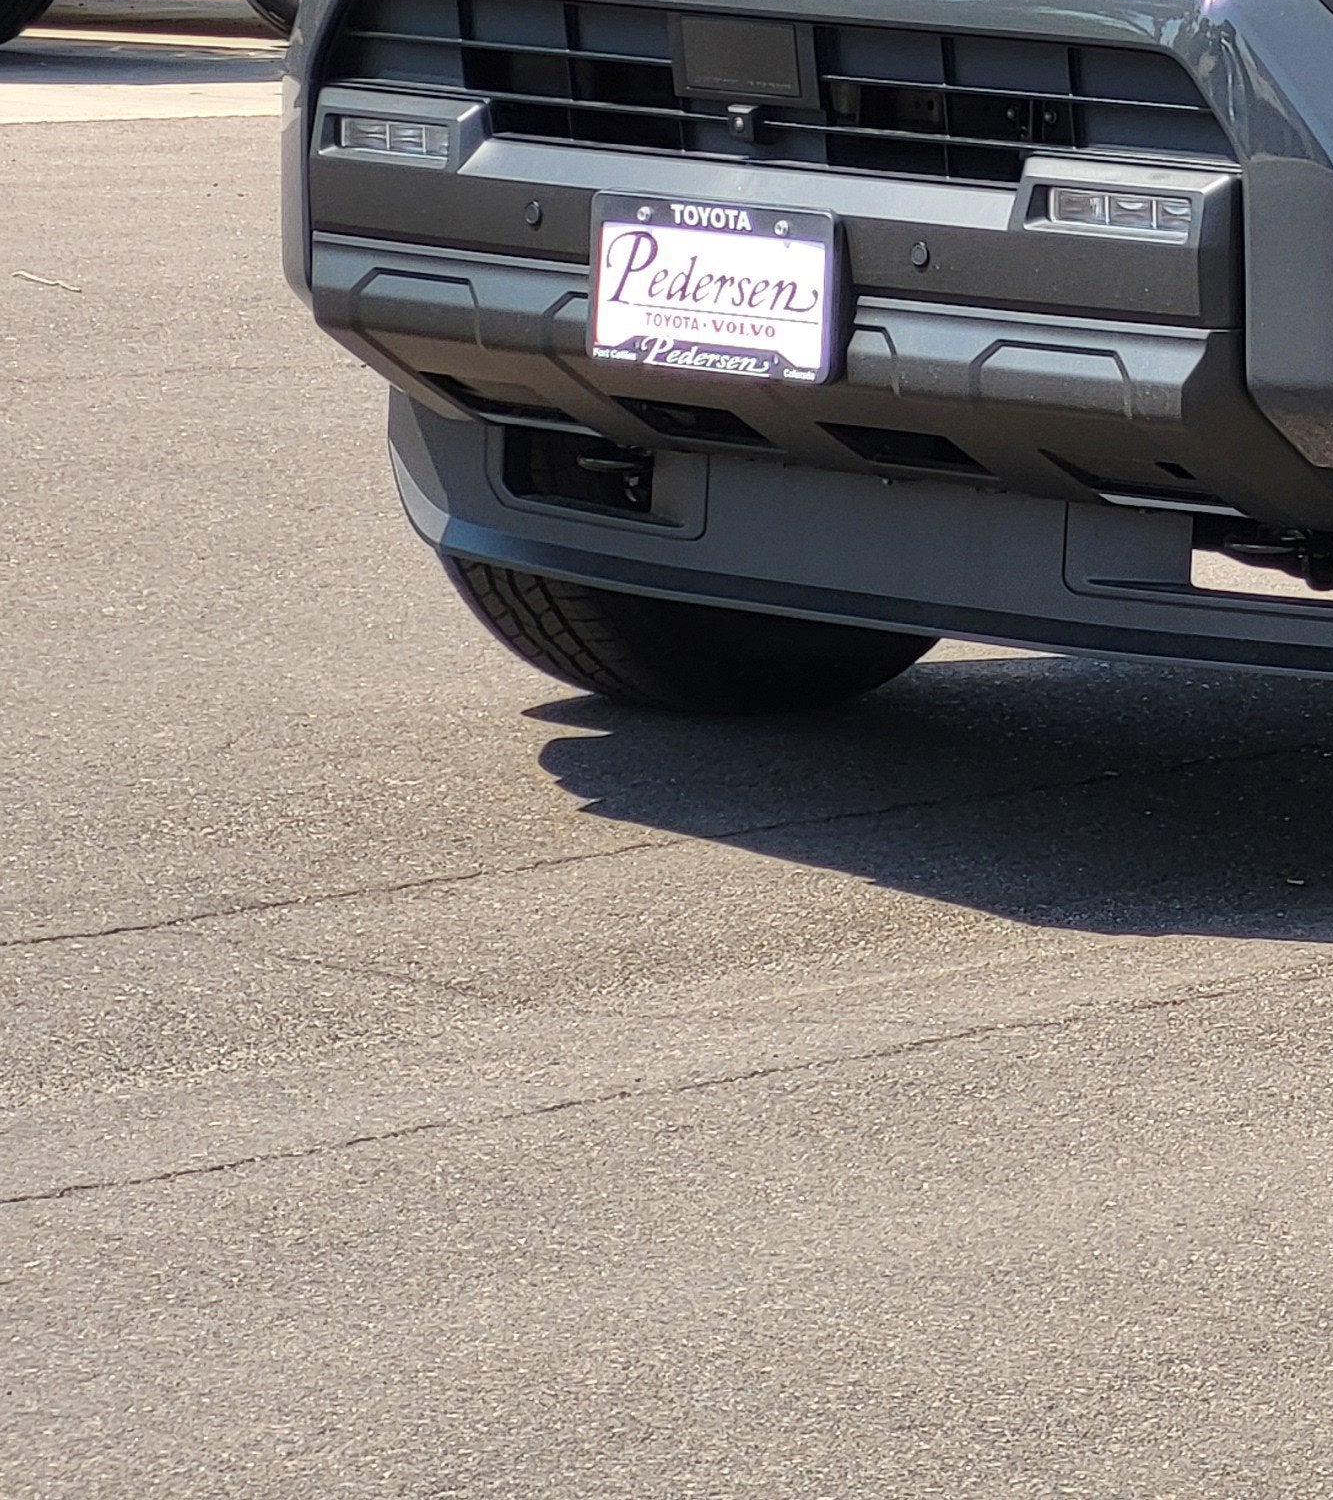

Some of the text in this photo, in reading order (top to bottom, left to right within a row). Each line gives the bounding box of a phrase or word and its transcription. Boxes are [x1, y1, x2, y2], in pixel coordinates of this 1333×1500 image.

[670, 203, 752, 232] TOYOTA
[606, 231, 819, 313] Pedersen
[645, 311, 776, 338] TOYOTA VOLVO
[641, 336, 770, 373] Pedersen
